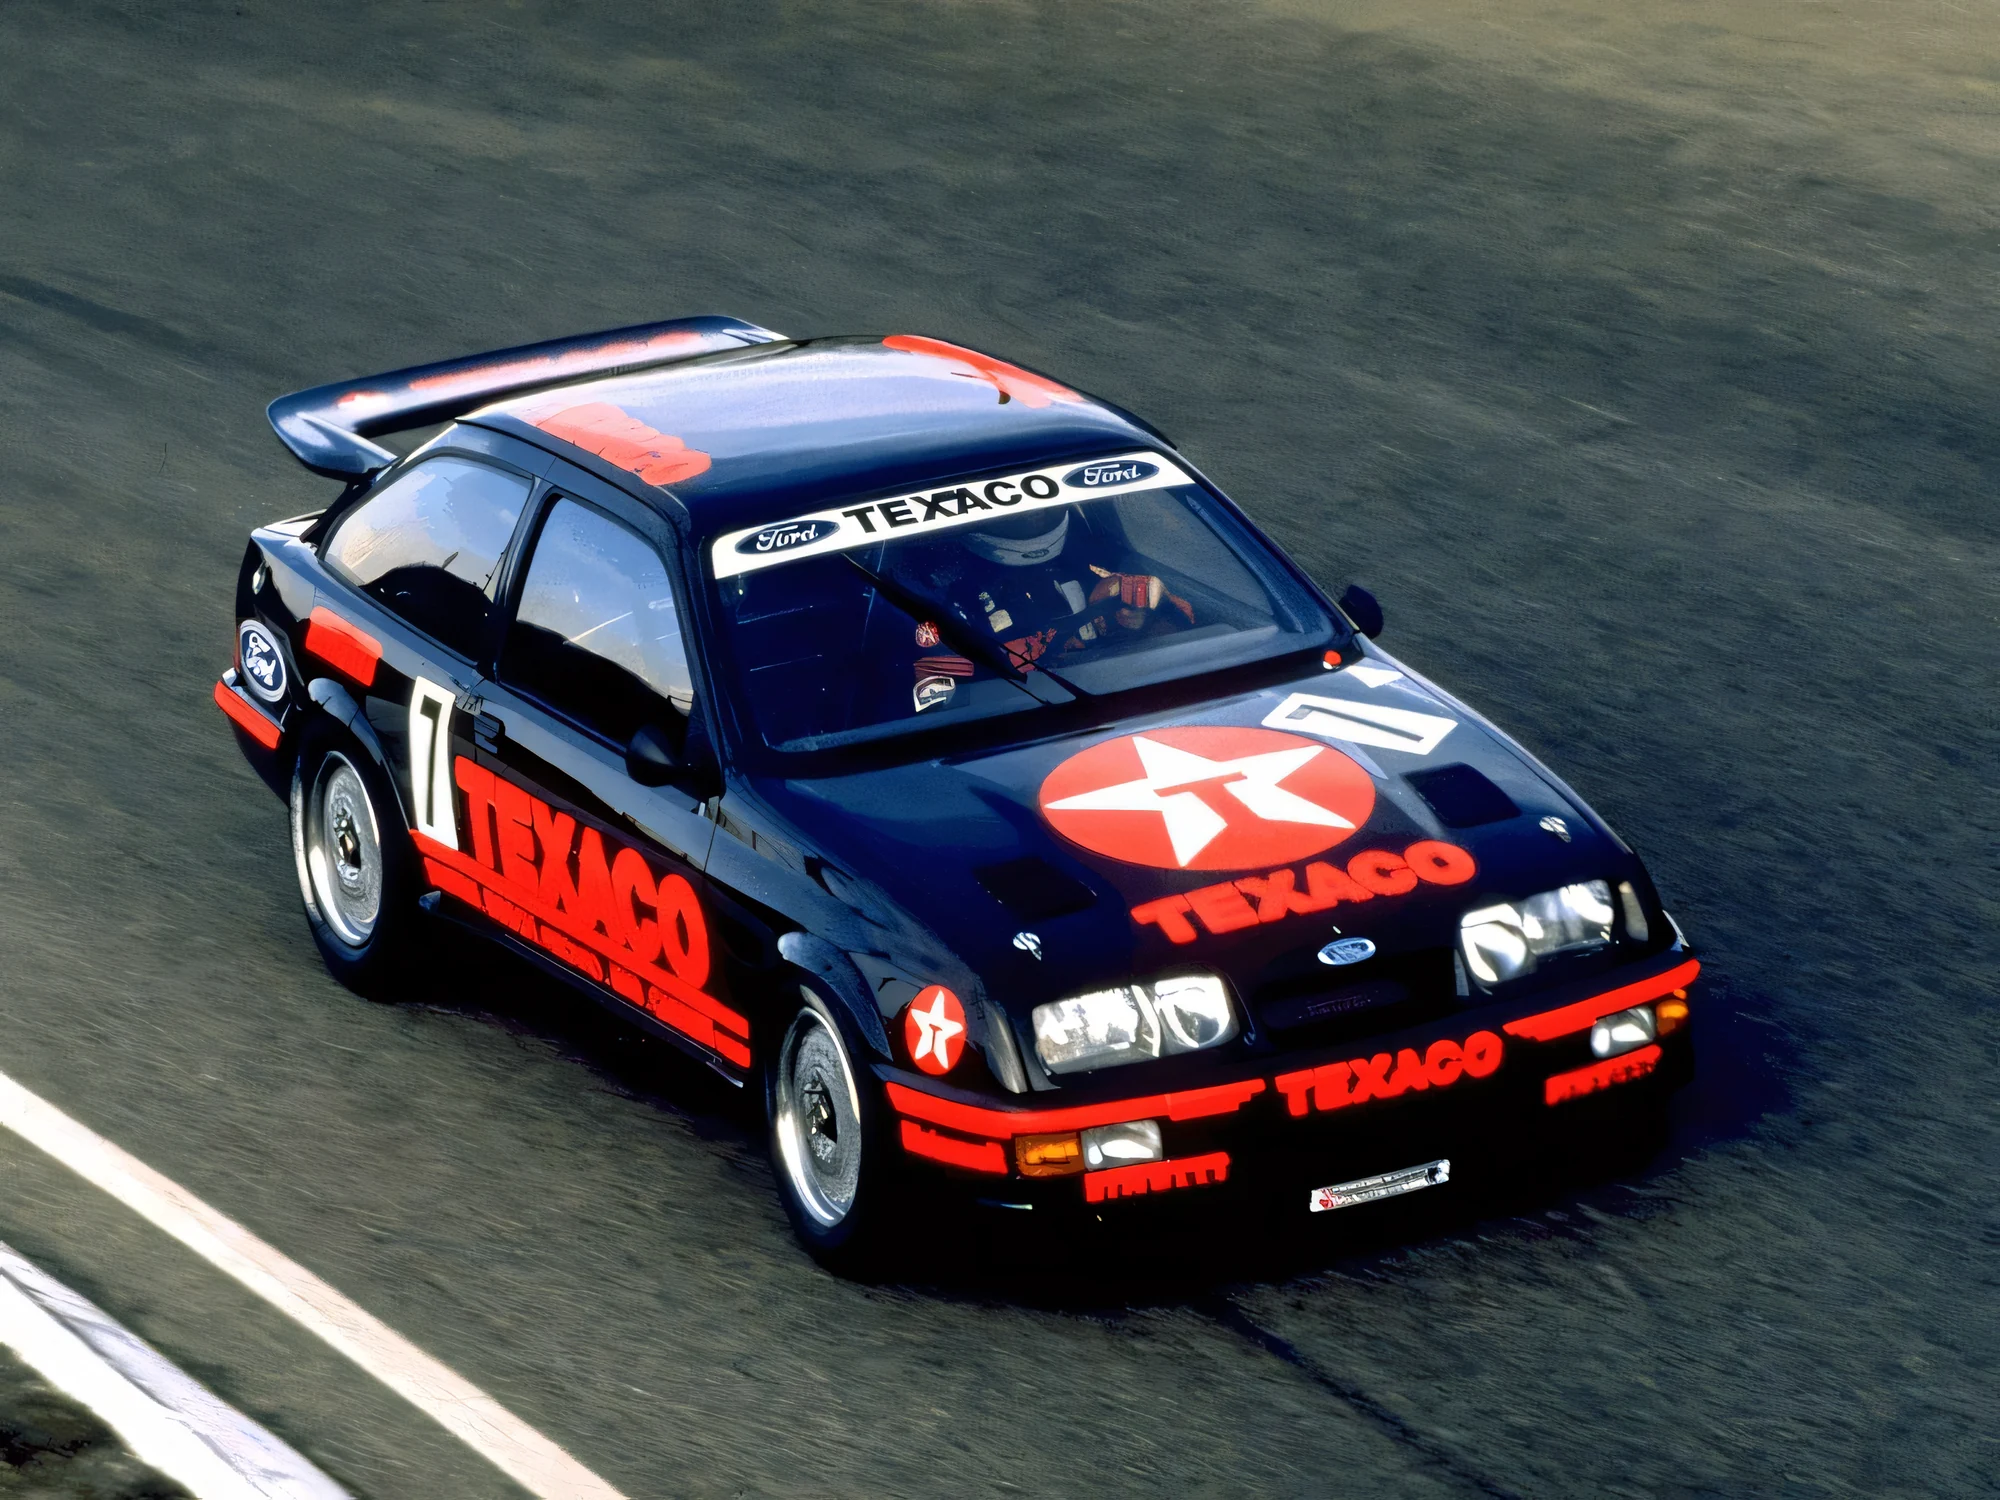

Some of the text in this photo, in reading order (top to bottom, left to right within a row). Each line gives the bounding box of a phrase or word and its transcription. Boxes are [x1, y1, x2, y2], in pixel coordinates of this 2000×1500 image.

[756, 463, 1142, 551] Ford TEXACO Ford
[455, 755, 710, 990] TEXACO
[1130, 839, 1476, 944] TEXACO
[1274, 1029, 1503, 1117] TEXACO
